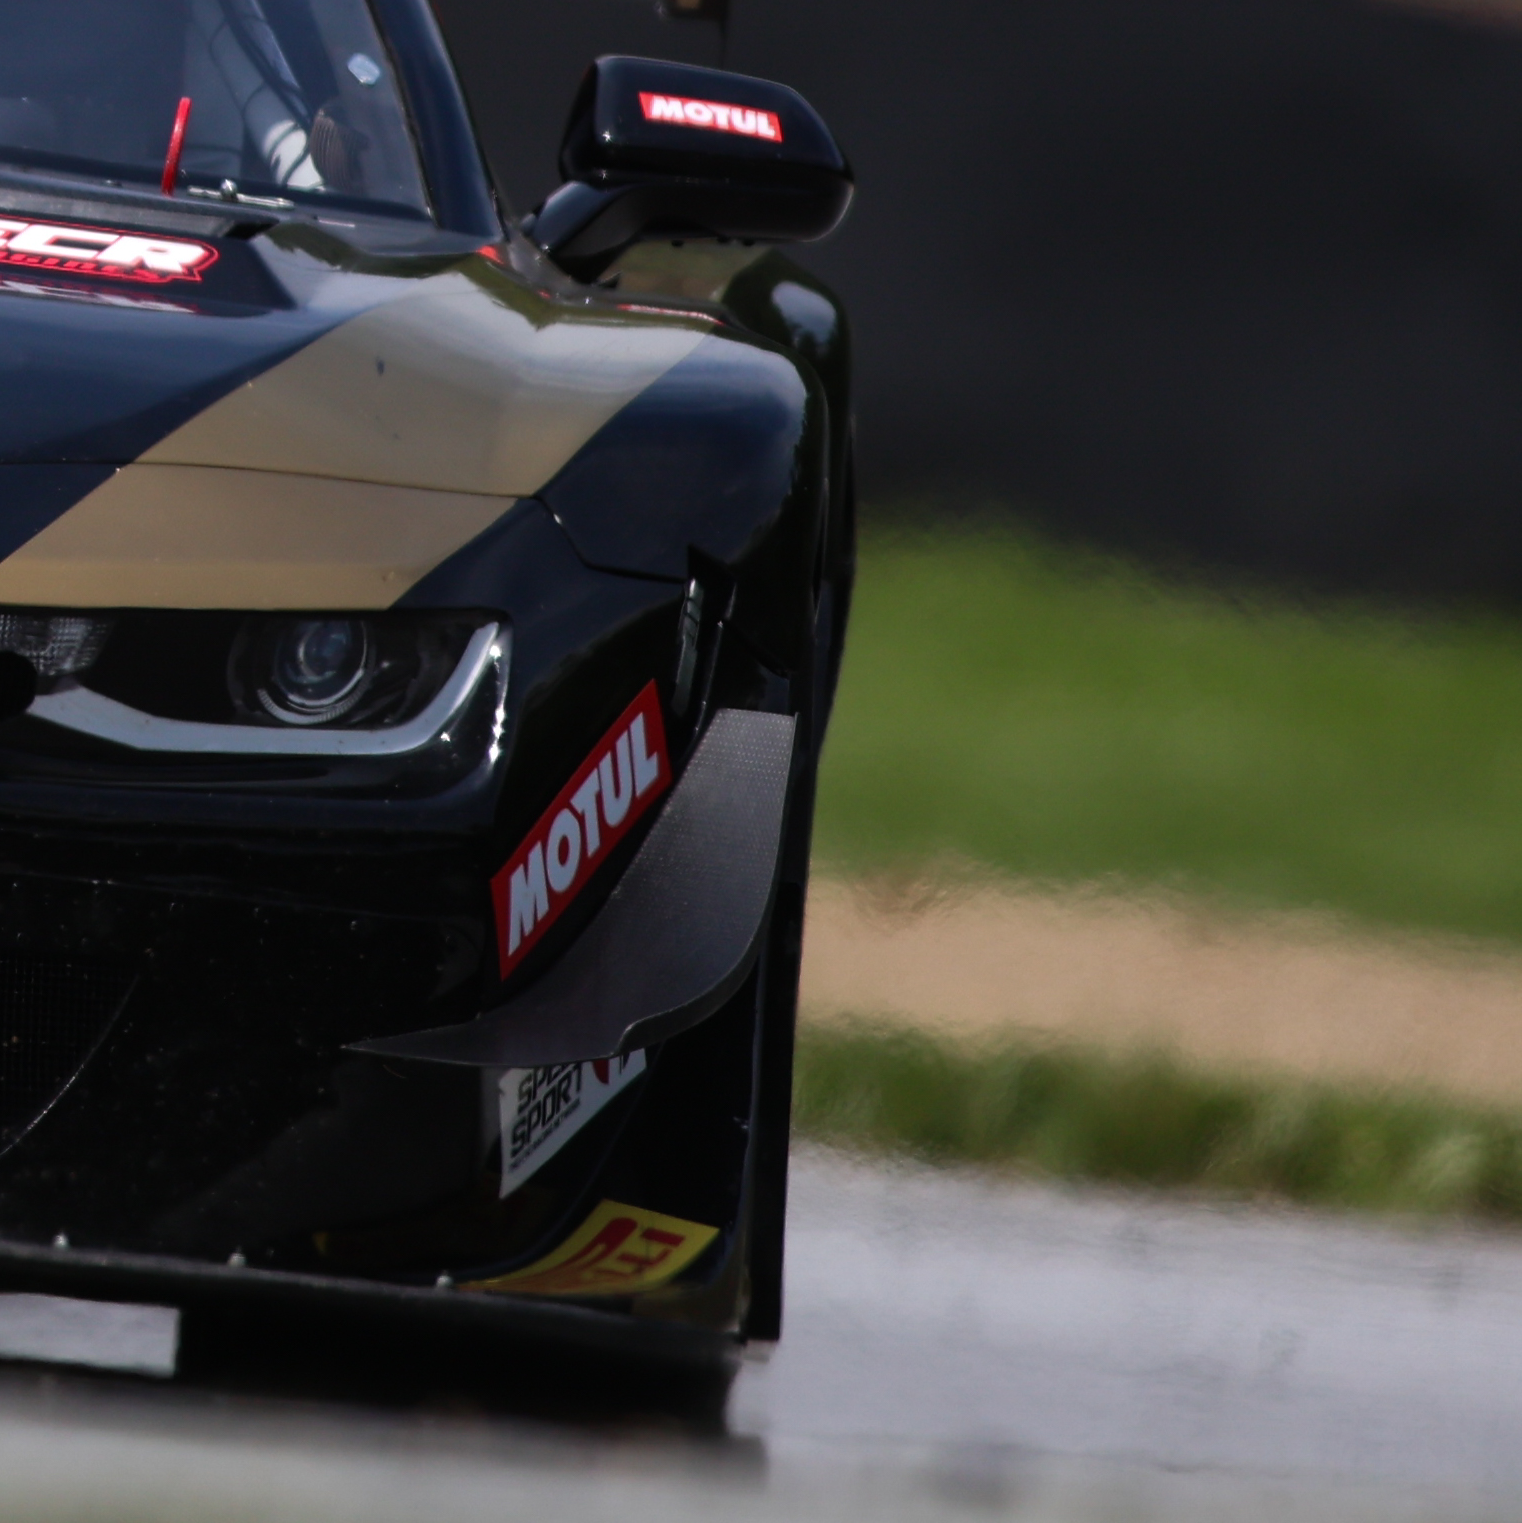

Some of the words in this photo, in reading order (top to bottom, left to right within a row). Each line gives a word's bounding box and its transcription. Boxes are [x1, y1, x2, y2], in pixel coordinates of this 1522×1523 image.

[650, 95, 777, 139] MOTUL
[508, 712, 658, 957] MOTUL
[510, 1062, 583, 1158] SPORT
